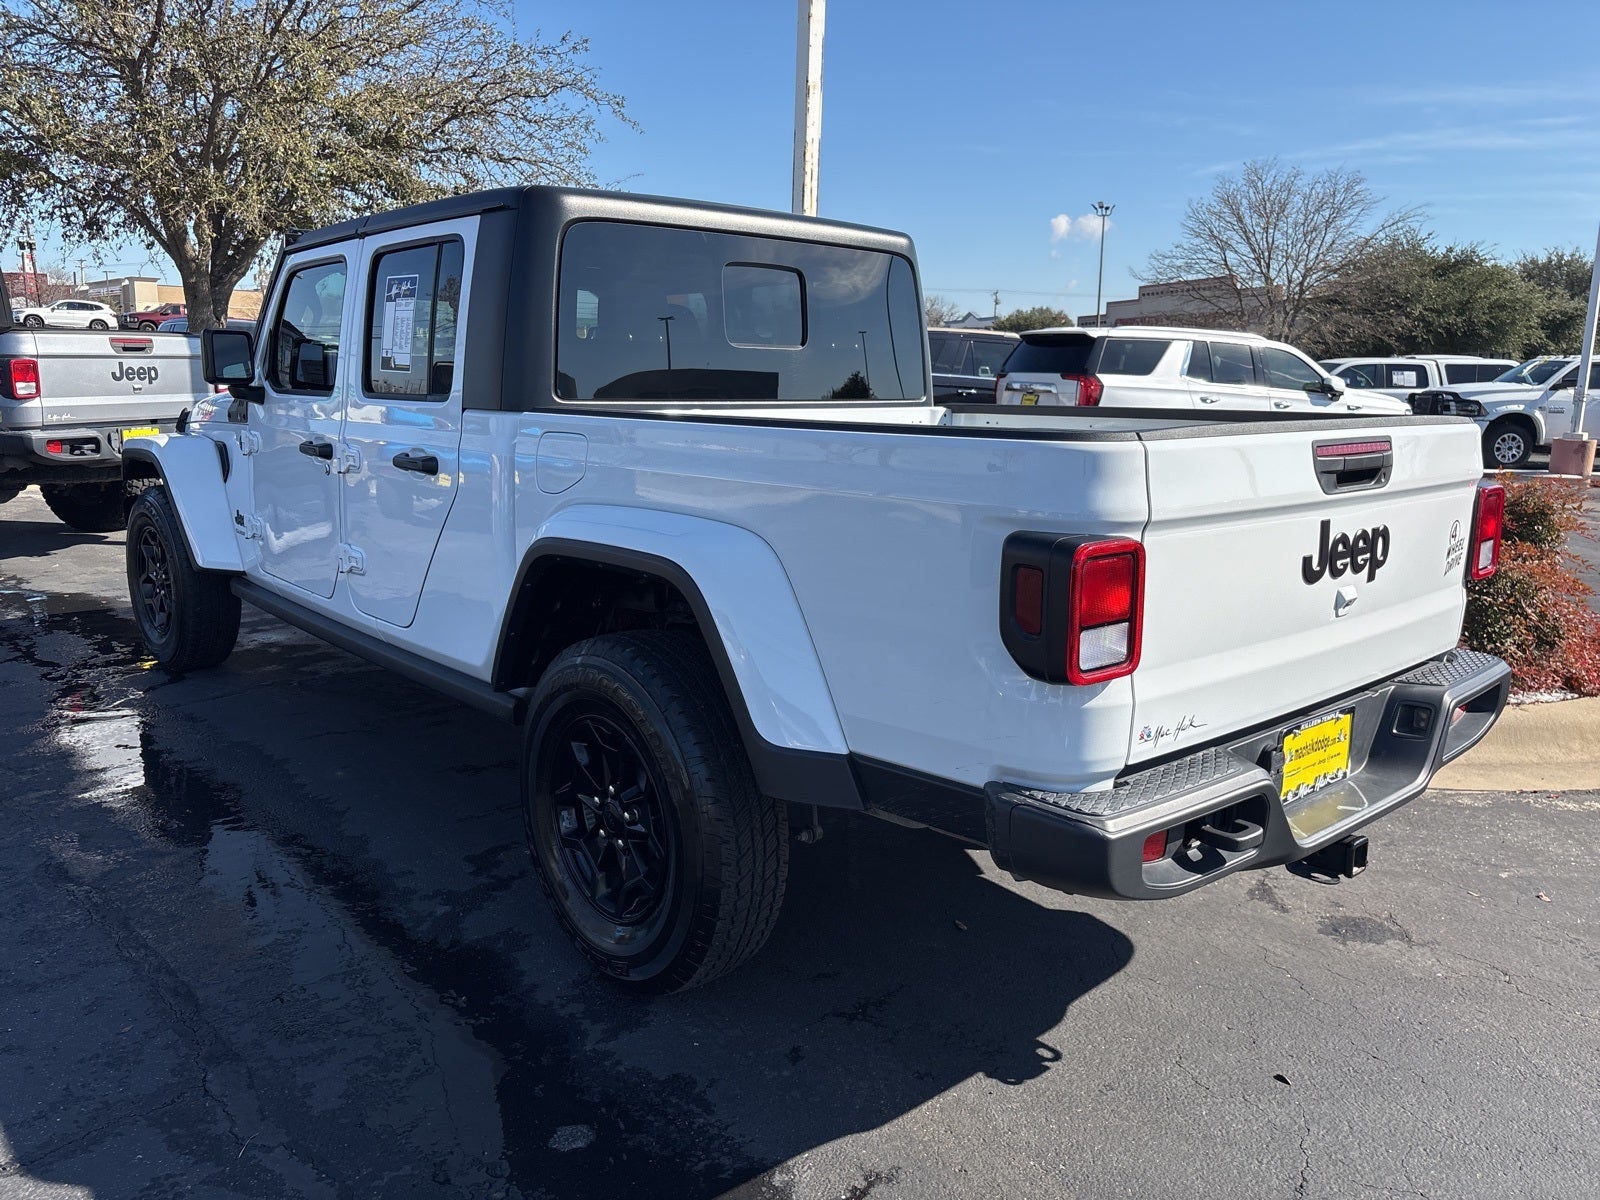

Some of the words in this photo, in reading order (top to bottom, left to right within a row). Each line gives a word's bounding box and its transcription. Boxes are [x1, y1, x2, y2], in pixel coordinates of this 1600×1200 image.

[111, 361, 159, 385] Jeep
[1302, 519, 1390, 586] Jeep
[1446, 537, 1466, 561] WHEEL
